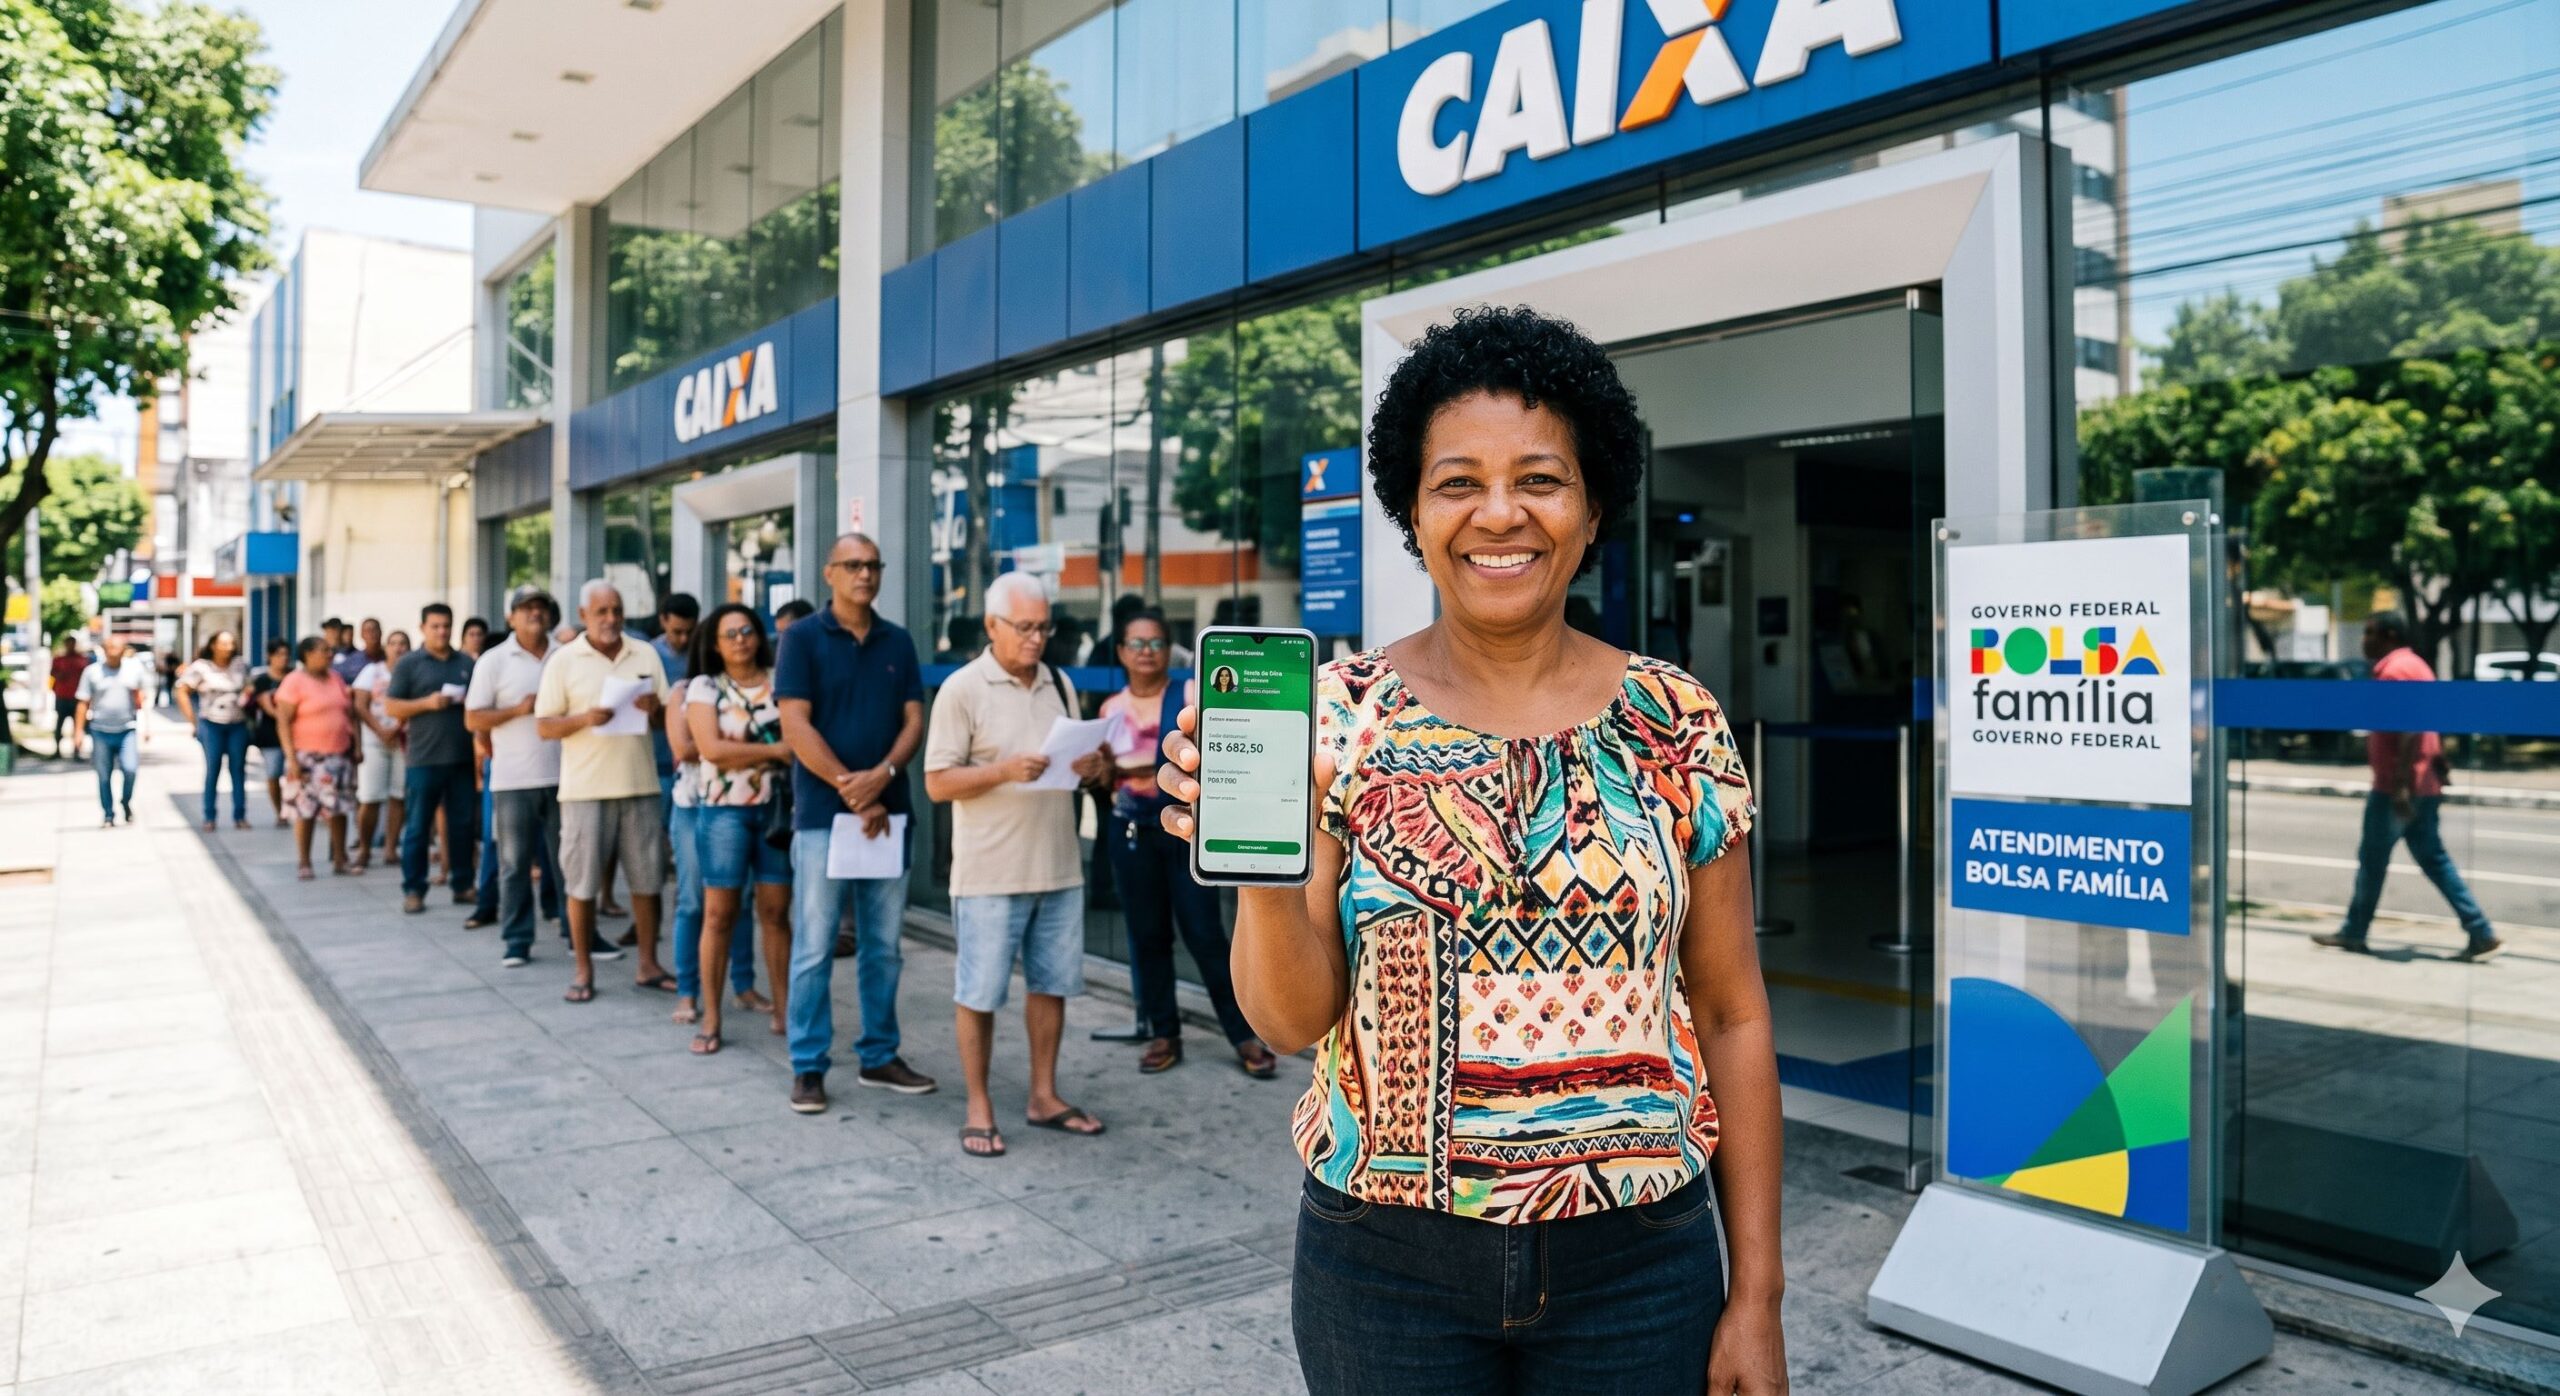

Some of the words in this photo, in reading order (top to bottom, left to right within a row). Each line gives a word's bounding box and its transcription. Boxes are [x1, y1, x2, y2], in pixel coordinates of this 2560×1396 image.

[674, 340, 778, 443] CAIXA
[1971, 604, 2062, 619] GOVERNO
[2070, 601, 2160, 617] FEDERAL
[1971, 625, 2166, 675] BOLSA
[1973, 678, 2153, 725] família
[1208, 742, 1222, 752] R$
[1226, 743, 1264, 754] 682,50
[1973, 730, 2063, 746] GOVERNO
[2071, 732, 2160, 749] FEDERAL
[1969, 828, 2165, 866] ATENDIMENTO
[1966, 860, 2050, 891] BOLSA
[2058, 868, 2169, 903] FAMÍLIA
